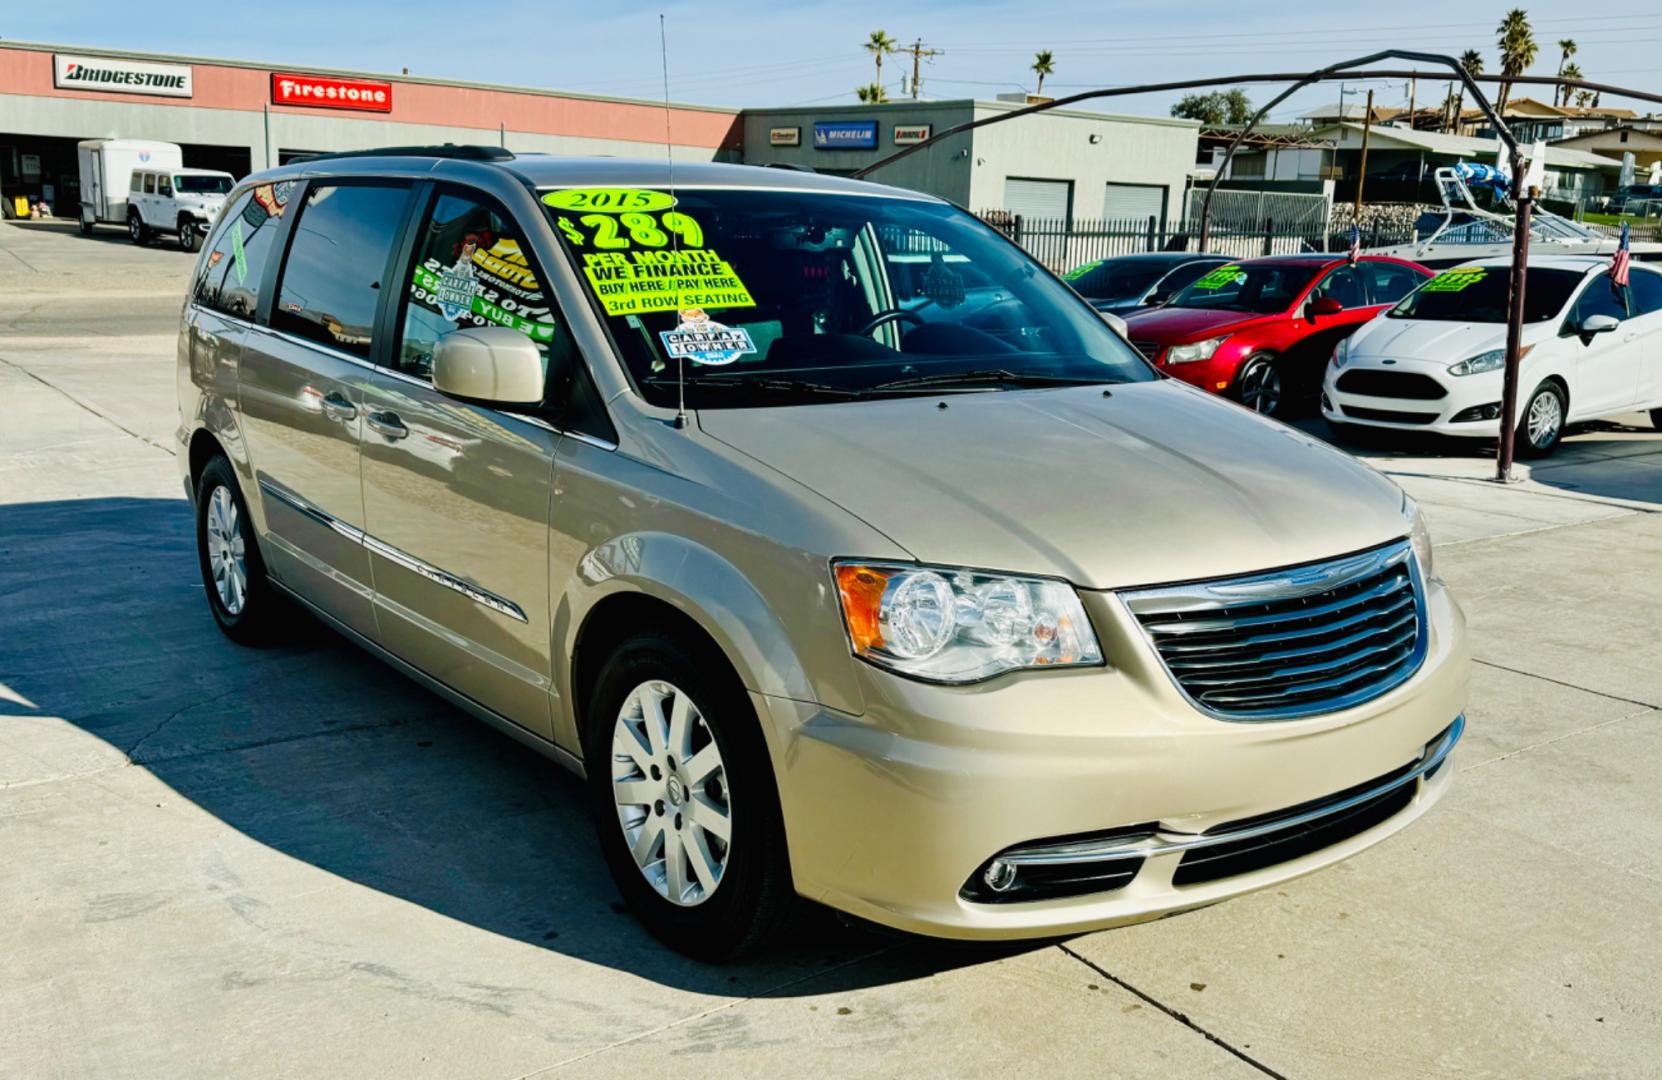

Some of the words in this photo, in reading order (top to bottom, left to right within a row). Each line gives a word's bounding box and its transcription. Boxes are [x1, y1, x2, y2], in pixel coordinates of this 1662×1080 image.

[64, 63, 187, 89] BRIDGESTONE
[280, 80, 386, 102] Firestone
[828, 129, 873, 139] MICHELIN
[569, 191, 653, 208] 2015
[557, 211, 704, 249] $289
[582, 252, 628, 268] PER
[632, 249, 721, 266] MONTH
[592, 266, 628, 281] WE
[635, 263, 723, 279] FINANCE
[599, 283, 626, 296] BUY
[630, 281, 664, 293] HERE
[677, 278, 701, 290] PAY
[704, 277, 738, 289] HERE
[608, 299, 636, 312] 3rd
[642, 295, 678, 308] ROW
[684, 293, 750, 306] SEATING
[668, 331, 746, 344] CARFAX
